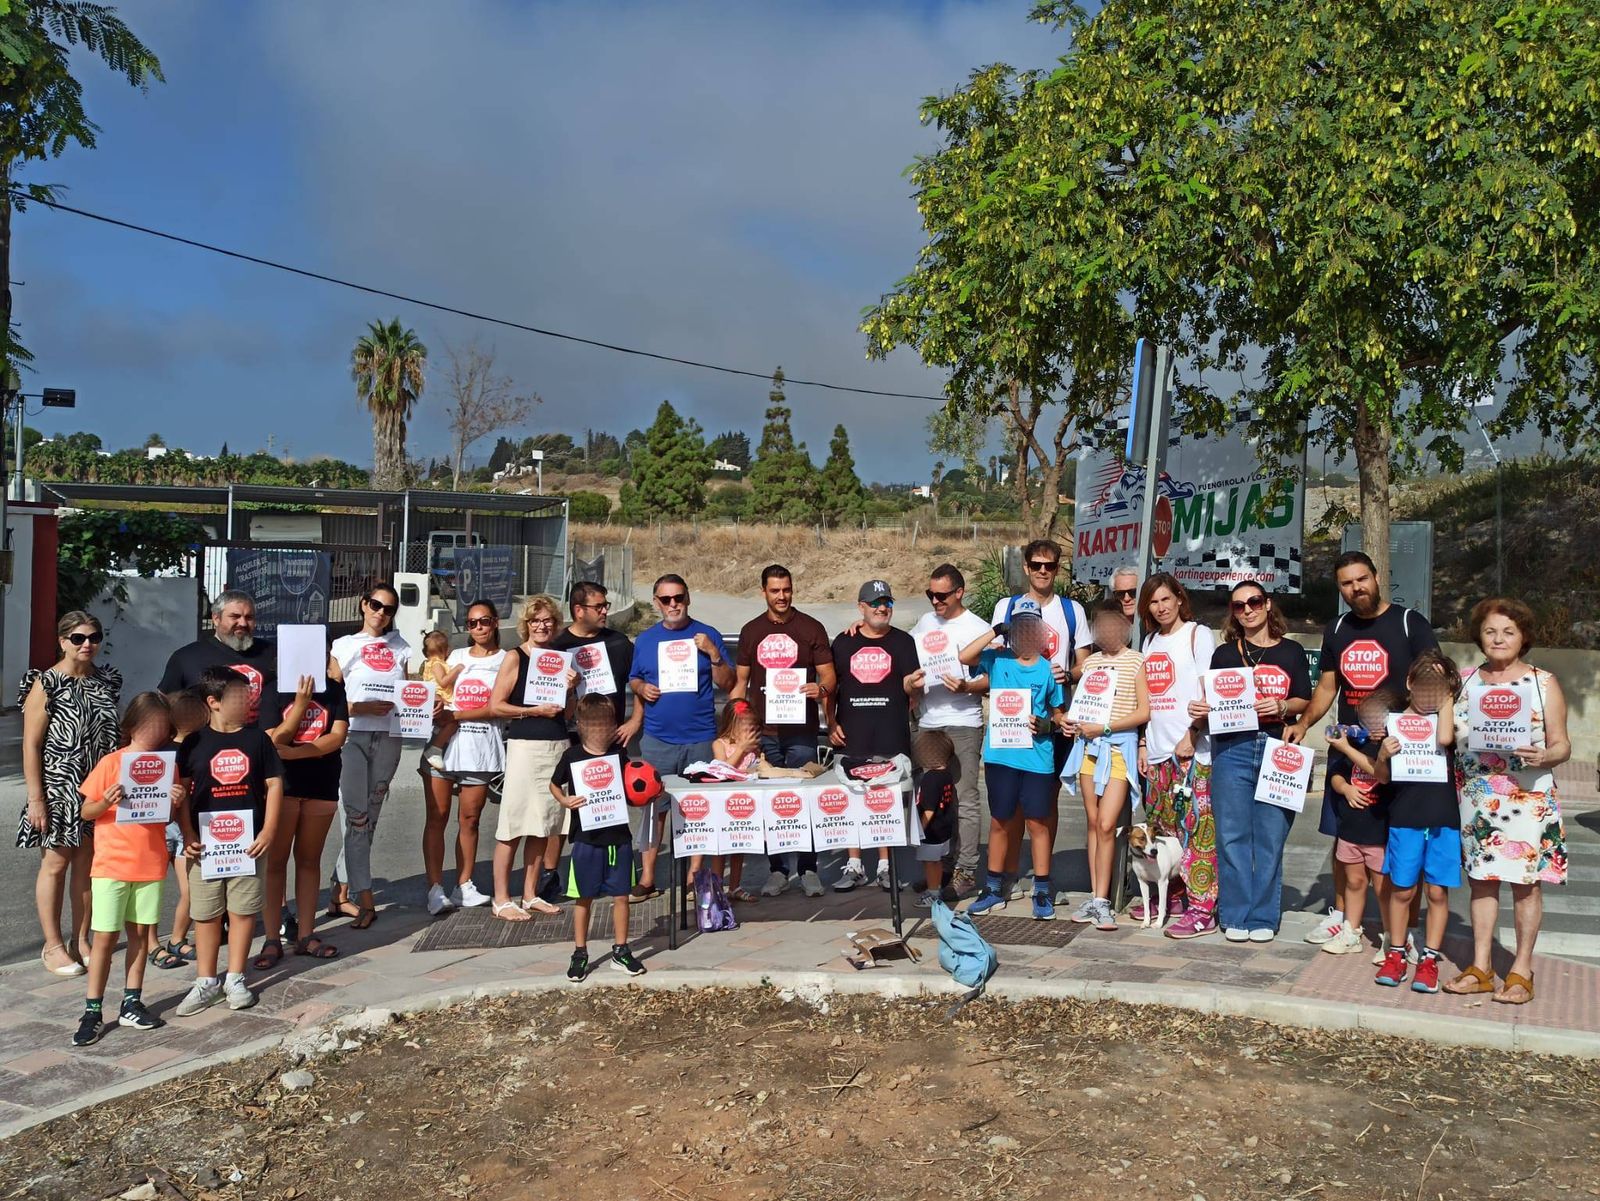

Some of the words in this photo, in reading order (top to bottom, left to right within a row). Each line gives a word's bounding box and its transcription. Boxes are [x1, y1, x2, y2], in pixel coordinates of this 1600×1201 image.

[1198, 478, 1244, 492] FUENGIROLA
[1154, 520, 1172, 534] STOP
[1174, 567, 1274, 582] kartingexperience.com
[926, 634, 944, 642] STOP
[763, 640, 792, 650] STOP
[761, 650, 794, 659] KARTING
[856, 653, 886, 662] STOP
[1348, 650, 1380, 662] STOP
[541, 655, 560, 664] STOP
[923, 657, 956, 667] KARTING
[1146, 661, 1168, 672] STOP
[1344, 663, 1382, 672] KARTING
[1147, 672, 1170, 681] ARTING
[1217, 676, 1240, 684] STOP
[458, 685, 486, 694] STOP
[1486, 695, 1516, 703] STOP
[1074, 700, 1108, 708] KARTING
[1276, 748, 1300, 760] STOP
[135, 760, 162, 768] STOP
[218, 756, 243, 765] STOP
[1274, 756, 1301, 767] KARTING
[214, 764, 245, 772] KARTING
[586, 765, 609, 776] STOP
[585, 772, 612, 781] KARTING
[1272, 771, 1296, 780] STOP
[1262, 774, 1302, 790] KARTING
[590, 790, 612, 798] STOP
[214, 819, 240, 827] STOP
[676, 828, 714, 836] KARTING
